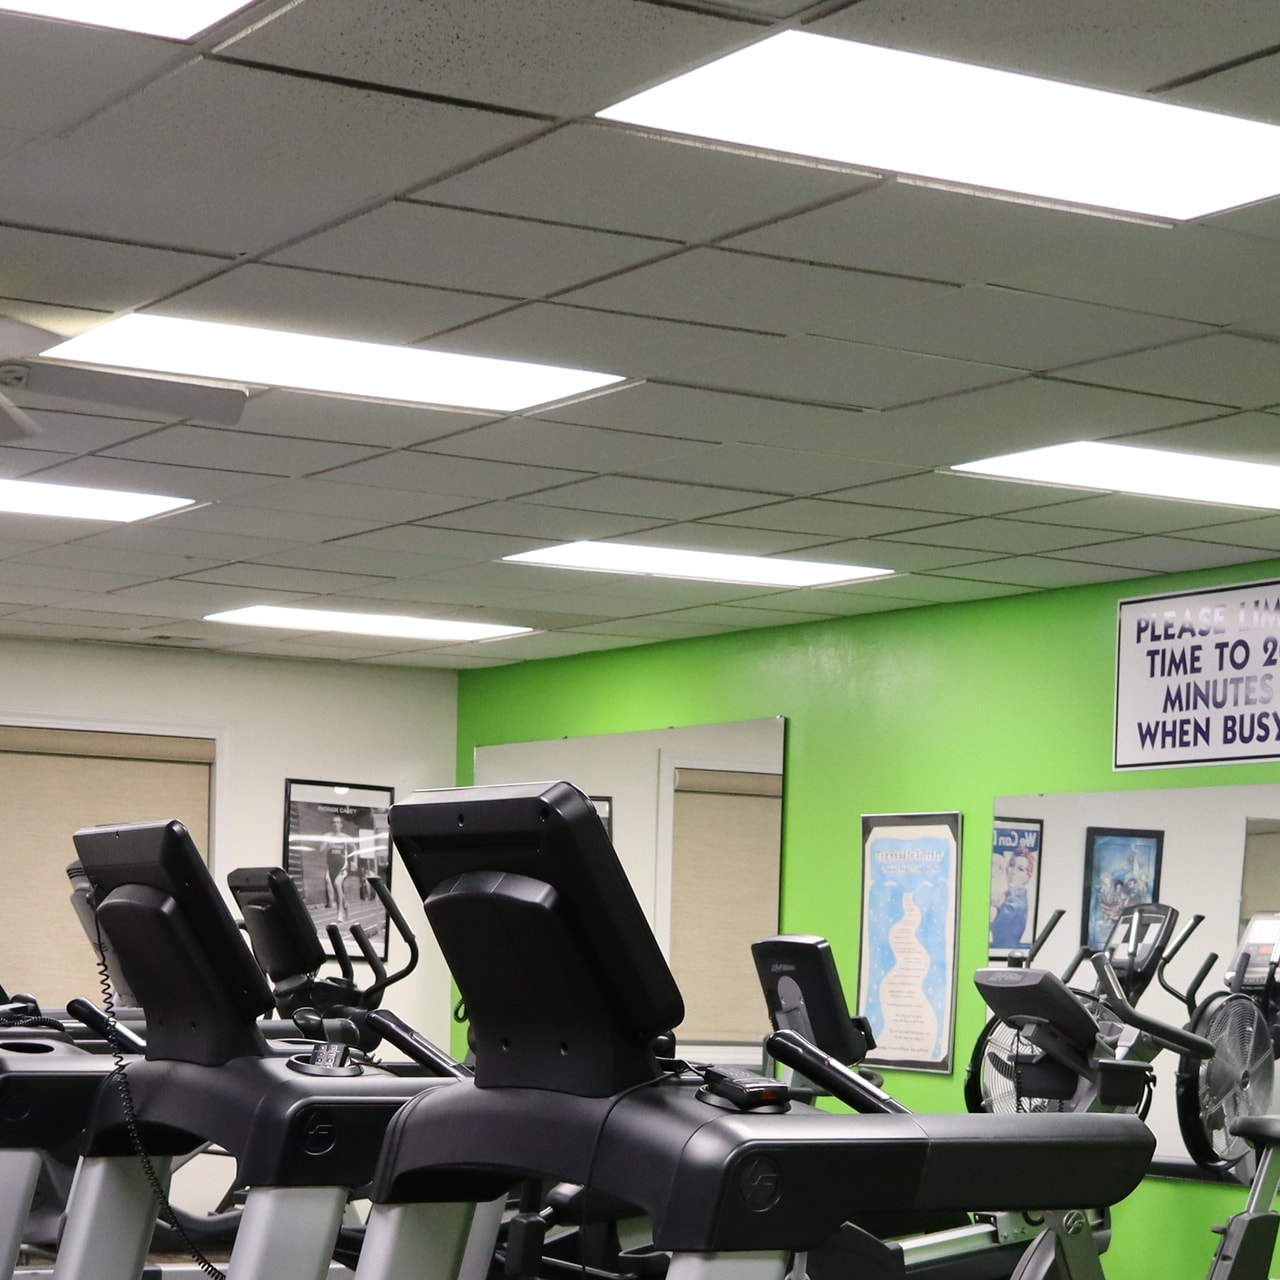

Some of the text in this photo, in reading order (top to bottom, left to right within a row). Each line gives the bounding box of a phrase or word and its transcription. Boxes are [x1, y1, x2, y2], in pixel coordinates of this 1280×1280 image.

[1136, 603, 1227, 645] PLEASE
[1146, 644, 1203, 678] TIME
[1214, 639, 1251, 672] TO
[1162, 673, 1274, 714] MINUTES
[1137, 716, 1211, 750] WHEN
